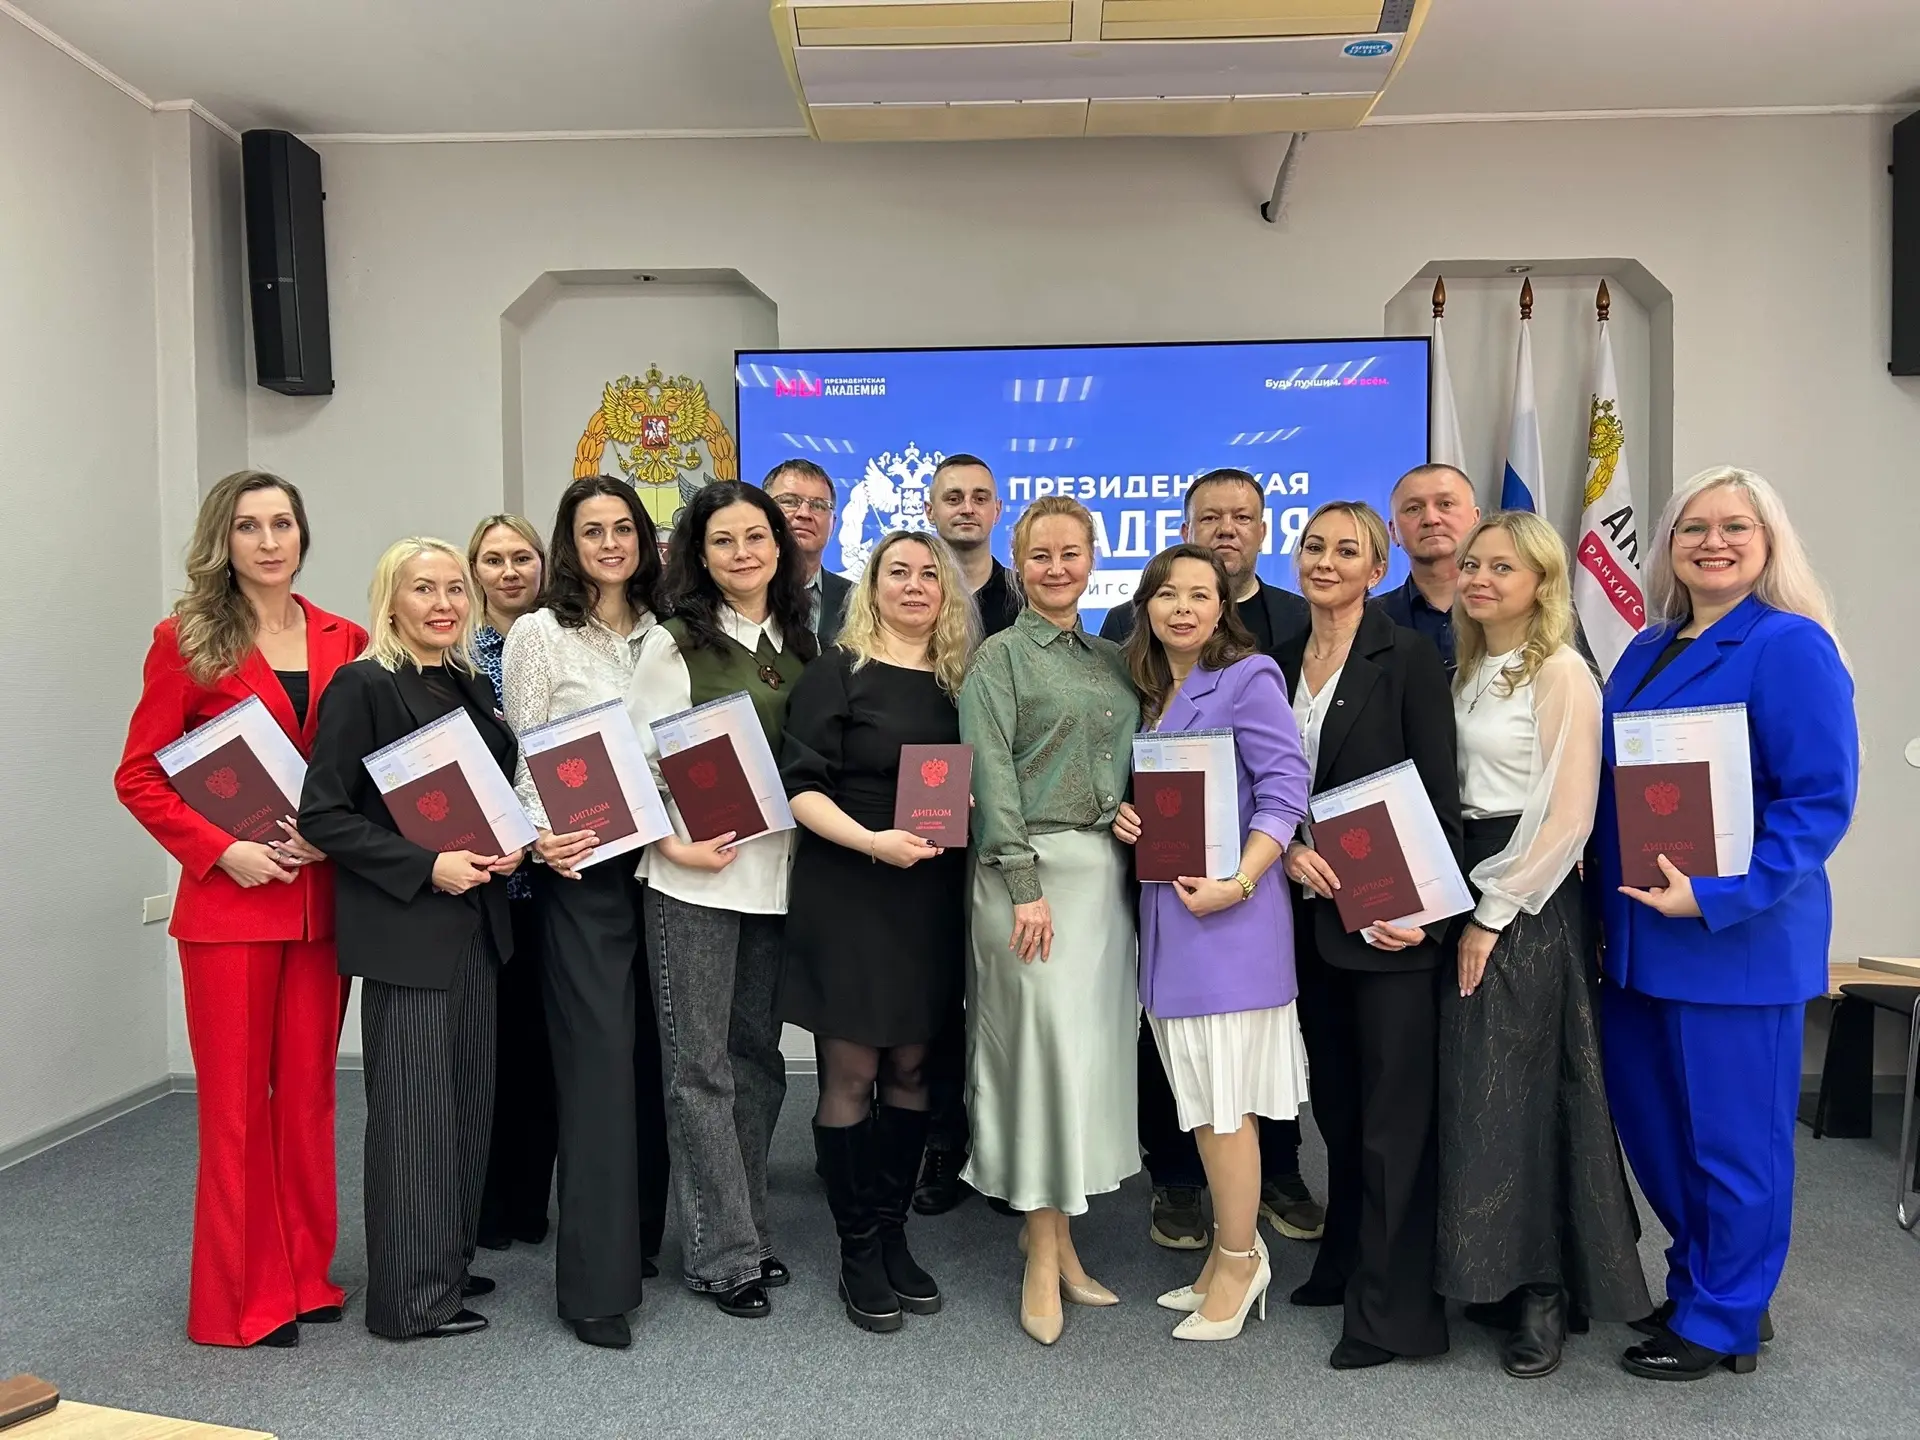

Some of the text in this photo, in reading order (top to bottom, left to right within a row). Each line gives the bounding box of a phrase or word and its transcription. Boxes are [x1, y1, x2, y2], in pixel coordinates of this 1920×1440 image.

[776, 378, 822, 397] МЫ
[824, 376, 886, 385] ПРЕЗИДЕНТСКАЯ
[824, 384, 886, 396] АКАДЕМИЯ
[1265, 378, 1292, 391] Будь
[1294, 378, 1341, 390] лучшим.
[1009, 471, 1310, 500] ПРЕЗИДЕНАЯ
[1584, 544, 1643, 616] РАНХИГС
[231, 804, 272, 836] ДИПЛОМ
[569, 801, 610, 824] ДИПЛОМ
[911, 808, 953, 818] ДИПЛОМ
[437, 832, 476, 851] ИПЛОМ
[1641, 840, 1695, 853] ДИПЛОМ
[1352, 876, 1395, 899] ДИПЛОМ
